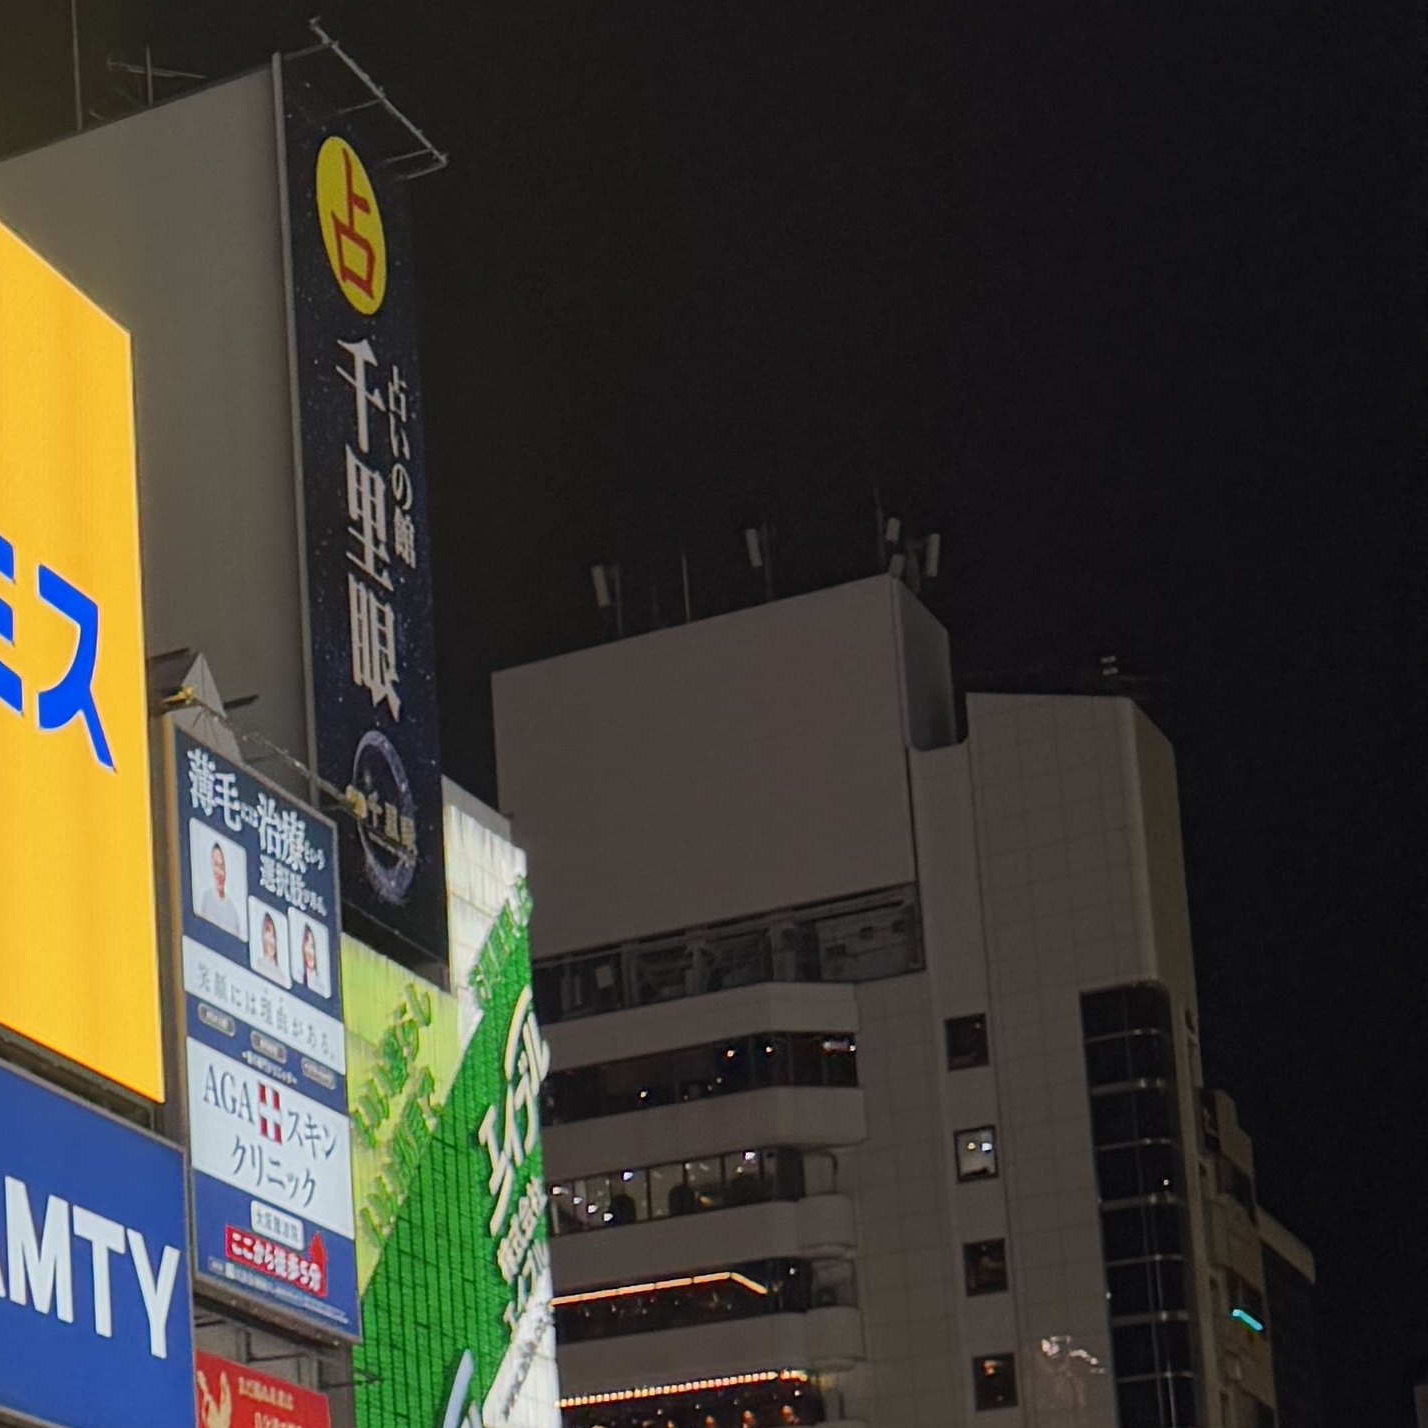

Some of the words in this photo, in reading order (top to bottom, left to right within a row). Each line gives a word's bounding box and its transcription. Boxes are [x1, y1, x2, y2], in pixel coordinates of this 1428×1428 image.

[329, 143, 377, 301] 占
[335, 337, 402, 723] 千里眼
[203, 1064, 256, 1126] AGA
[287, 1109, 337, 1161] スキン
[231, 1133, 317, 1209] クリニック
